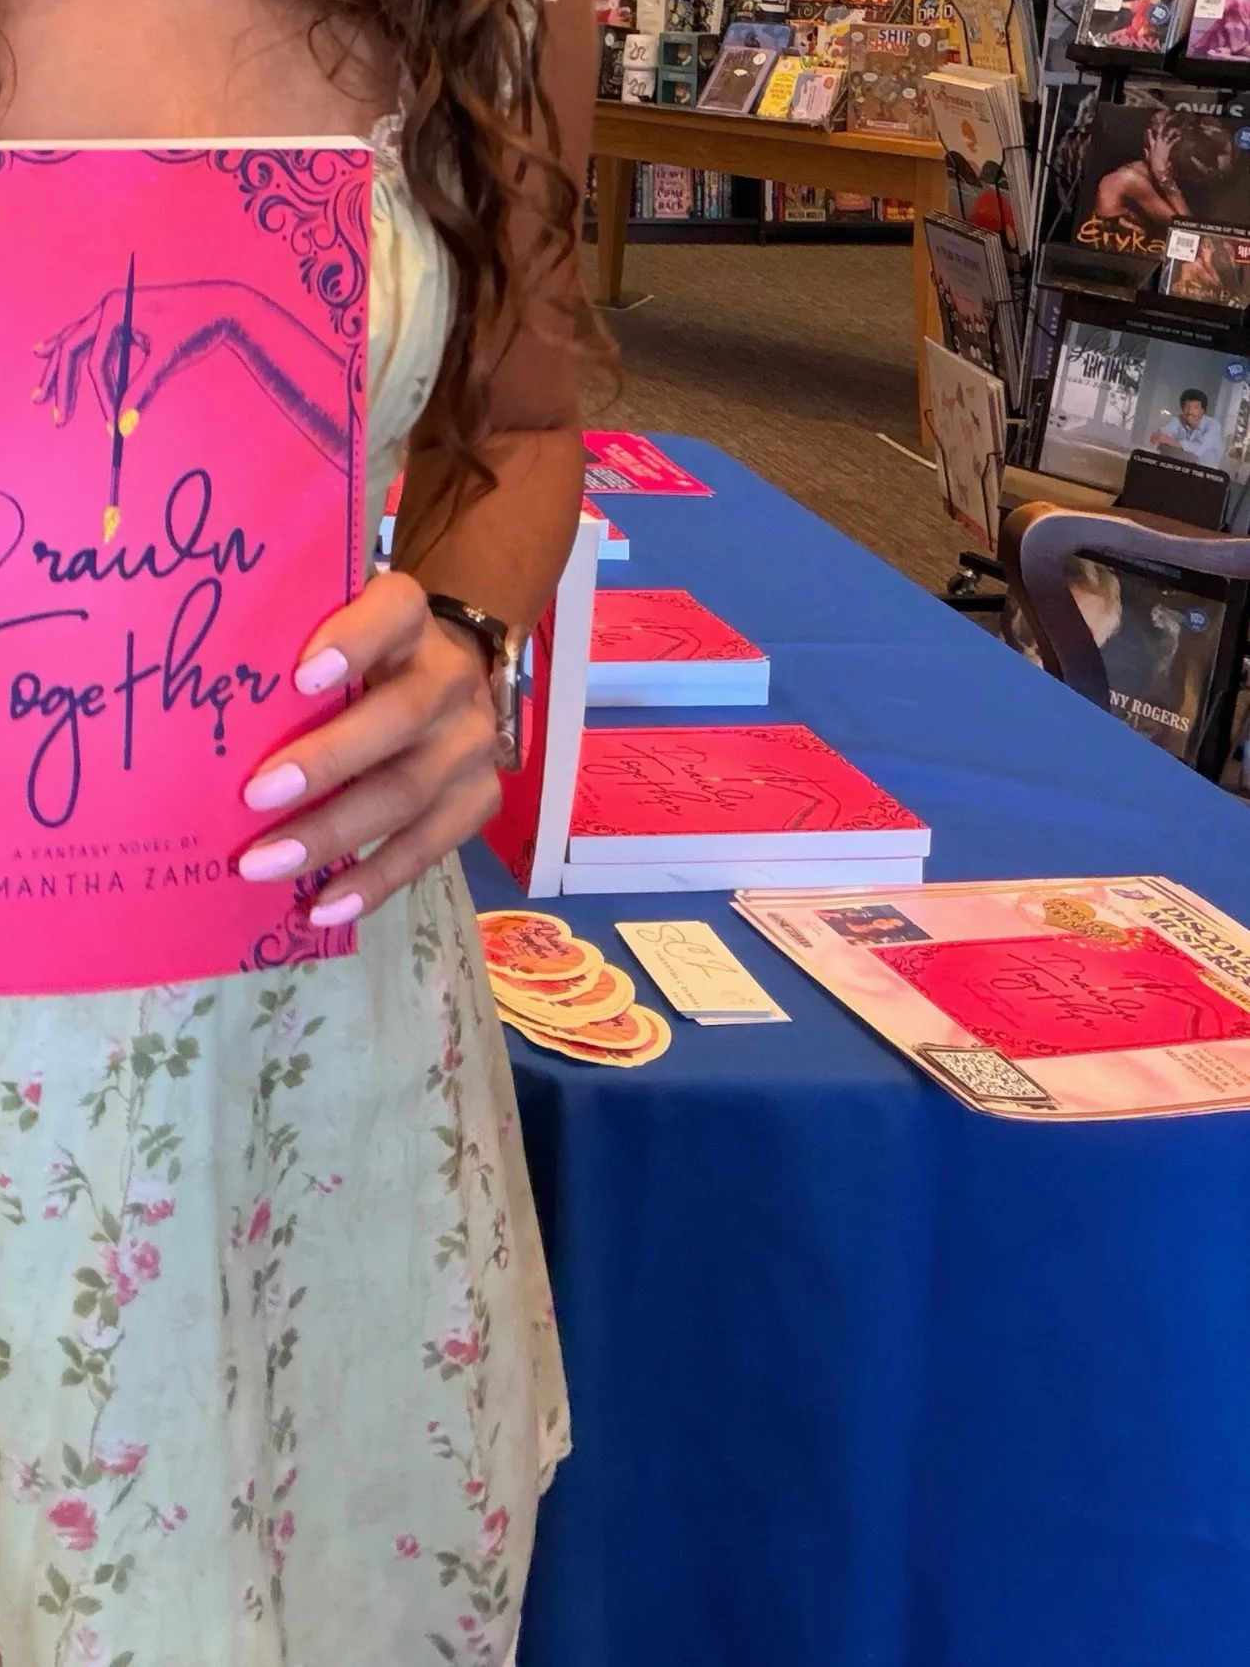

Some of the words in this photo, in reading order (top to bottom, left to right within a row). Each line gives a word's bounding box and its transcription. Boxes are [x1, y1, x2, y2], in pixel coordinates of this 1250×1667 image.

[880, 29, 913, 41] SHIP
[1077, 212, 1166, 254] Eryka
[1109, 690, 1130, 710] NY
[1131, 698, 1190, 732] ROGERS
[14, 849, 22, 860] A
[31, 845, 108, 860] FANTASY
[118, 839, 169, 854] NOVEL
[180, 836, 198, 849] BY
[144, 856, 240, 890] ZAMOR
